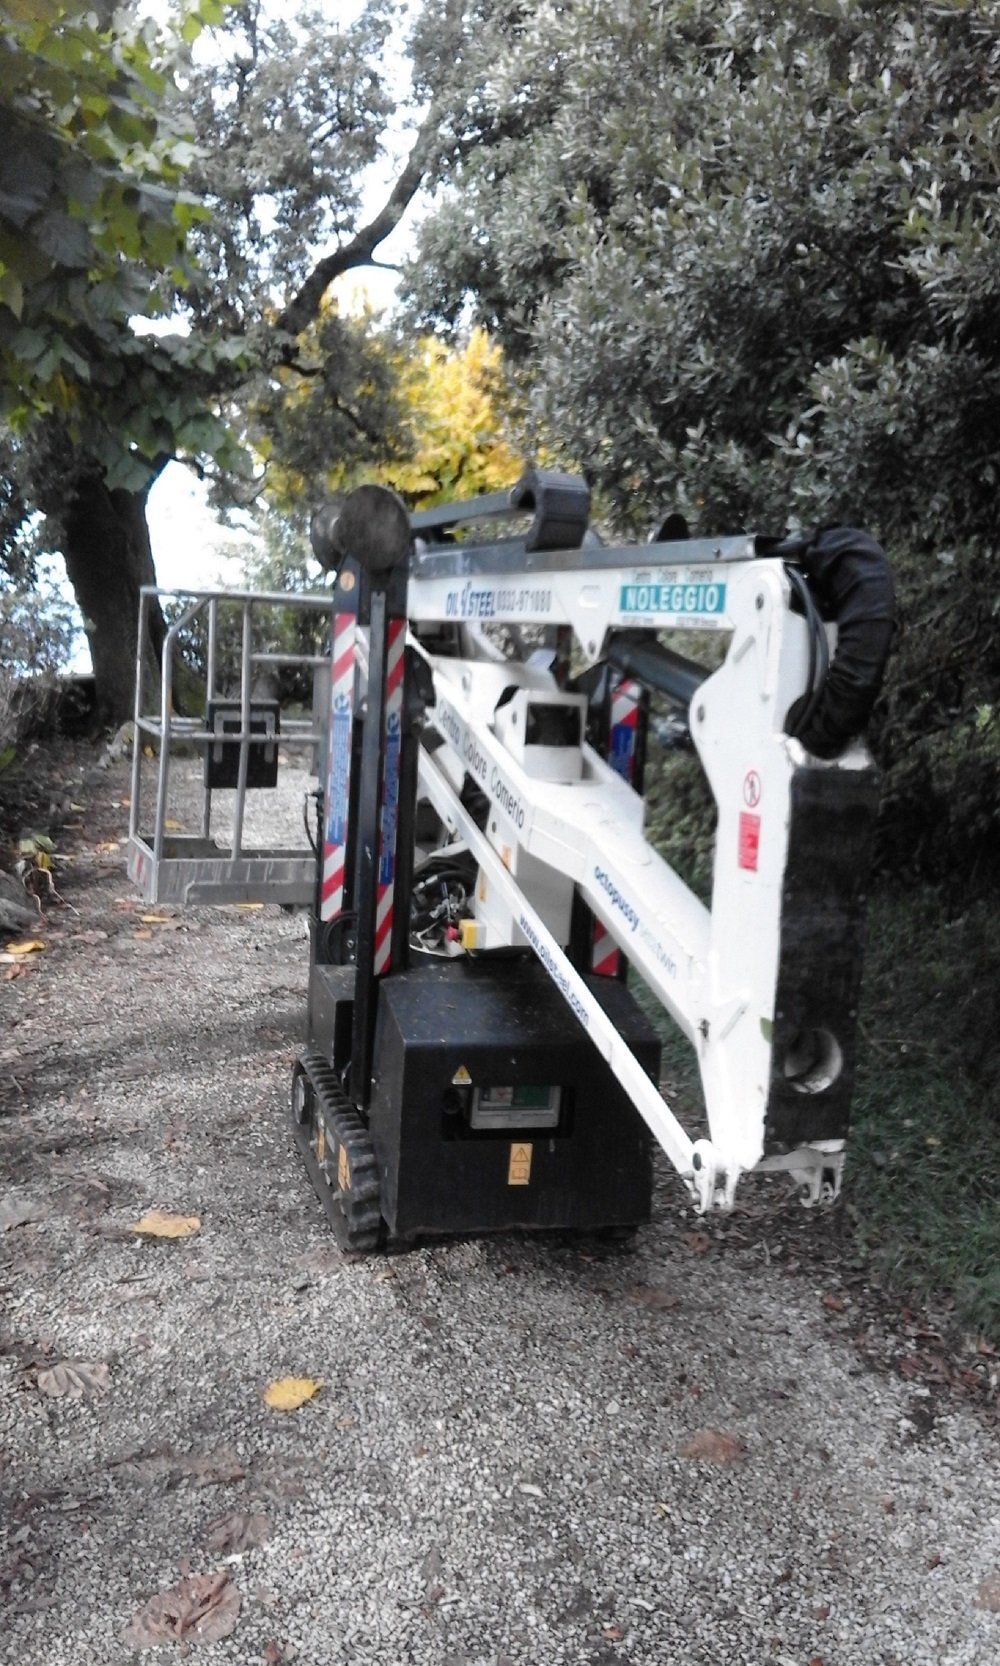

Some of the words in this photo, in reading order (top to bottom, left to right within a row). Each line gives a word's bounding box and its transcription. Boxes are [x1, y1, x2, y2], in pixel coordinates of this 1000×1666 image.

[626, 586, 719, 612] NOLEGGIO
[463, 722, 488, 780] Colore
[491, 765, 526, 829] Comerio
[594, 865, 640, 932] octopussy
